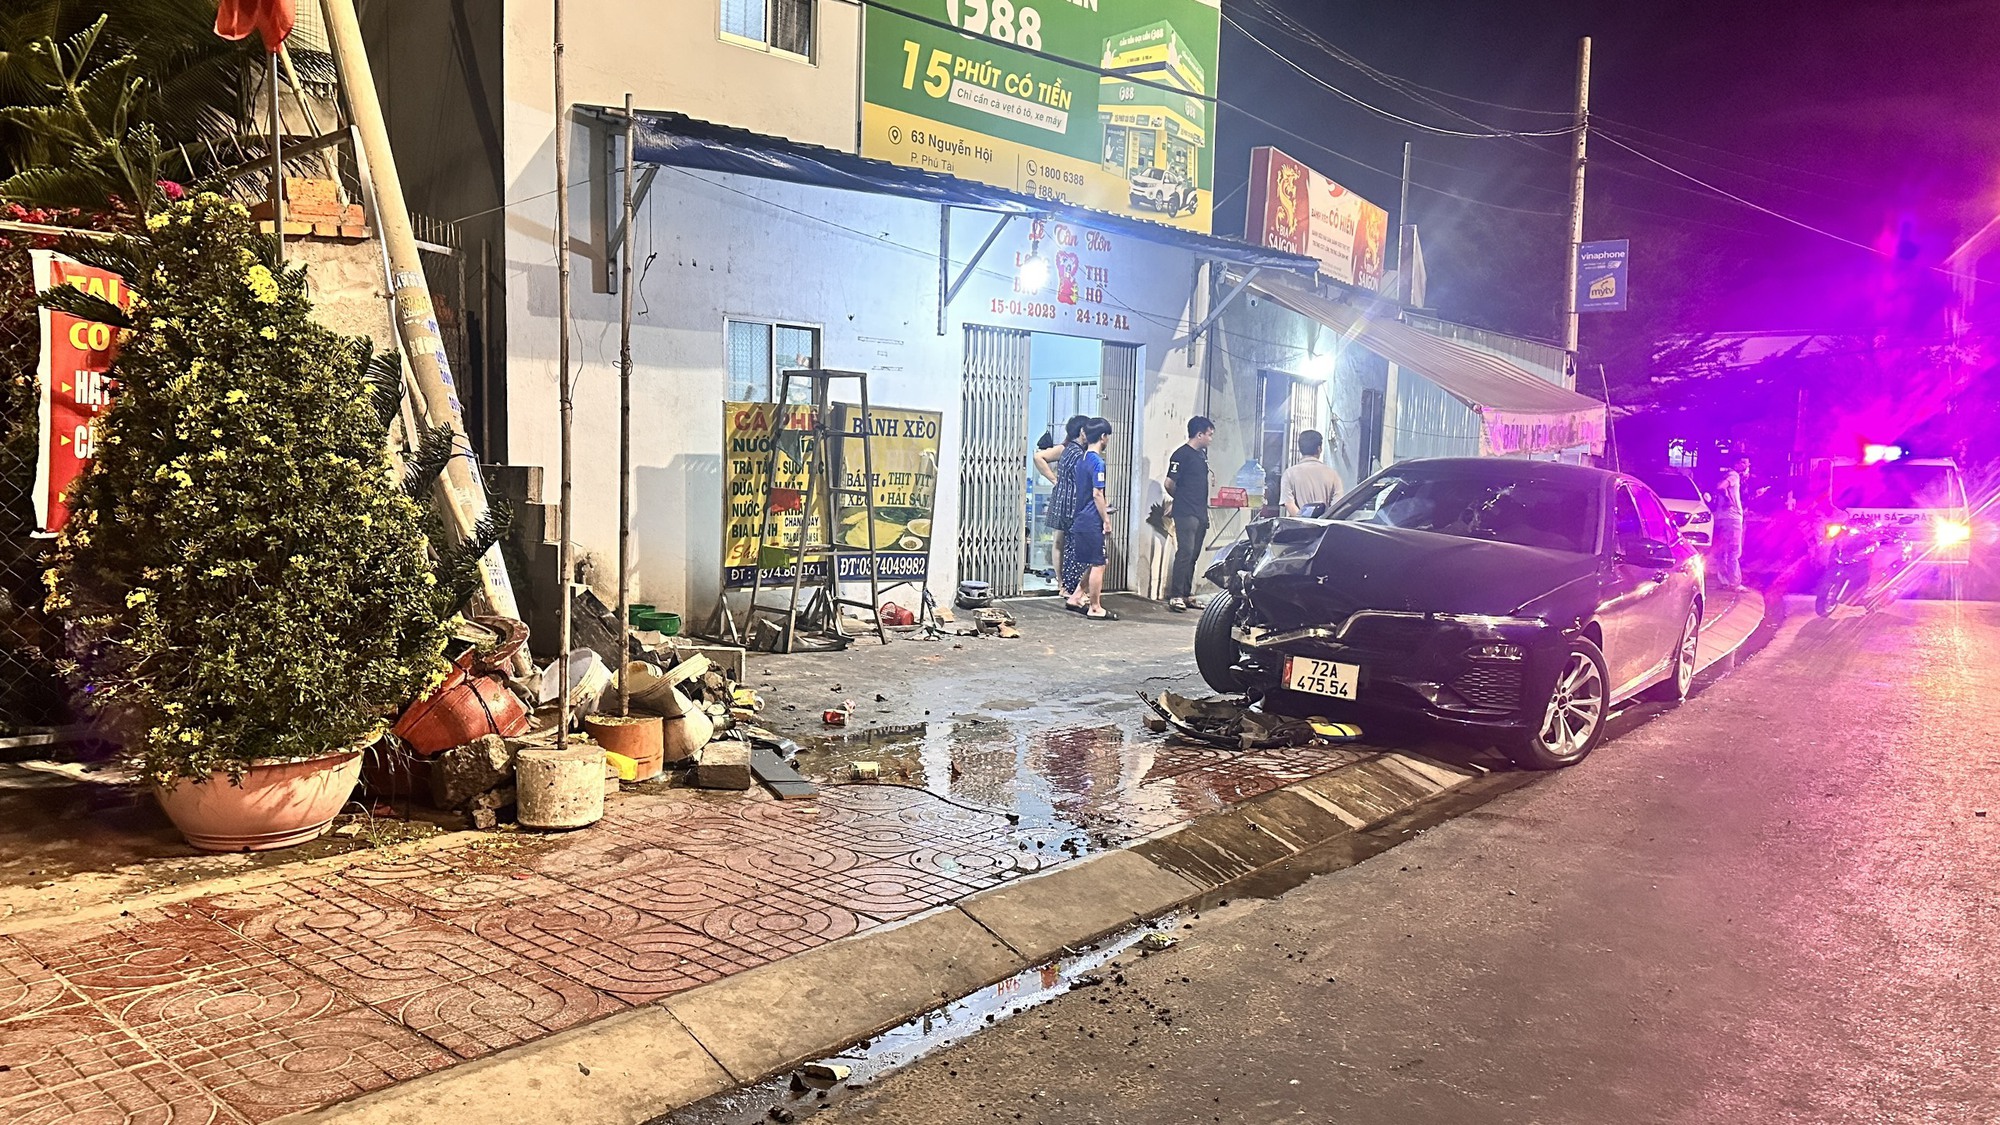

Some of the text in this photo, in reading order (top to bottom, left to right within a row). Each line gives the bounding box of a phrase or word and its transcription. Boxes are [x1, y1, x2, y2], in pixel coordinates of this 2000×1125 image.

[902, 39, 1072, 110] 15 PHÚT CÓ TIỀN
[1035, 111, 1044, 122] xe
[1045, 113, 1062, 128] máy
[911, 129, 993, 165] 63 Nguyễn Hội
[910, 151, 919, 164] P.
[921, 154, 939, 169] Phú
[1039, 165, 1084, 186] 1800 6388
[1038, 184, 1066, 200] f88.vn
[1268, 232, 1298, 255] SAIGON
[1581, 250, 1626, 260] vinaphone
[1591, 286, 1614, 297] mytv
[734, 406, 768, 432] CÀ
[852, 412, 936, 440] BÁNH XÈO
[733, 434, 770, 453] NƯỚ
[732, 524, 748, 539] BIA
[1311, 661, 1338, 678] 72A
[1297, 676, 1348, 696] 475.54
